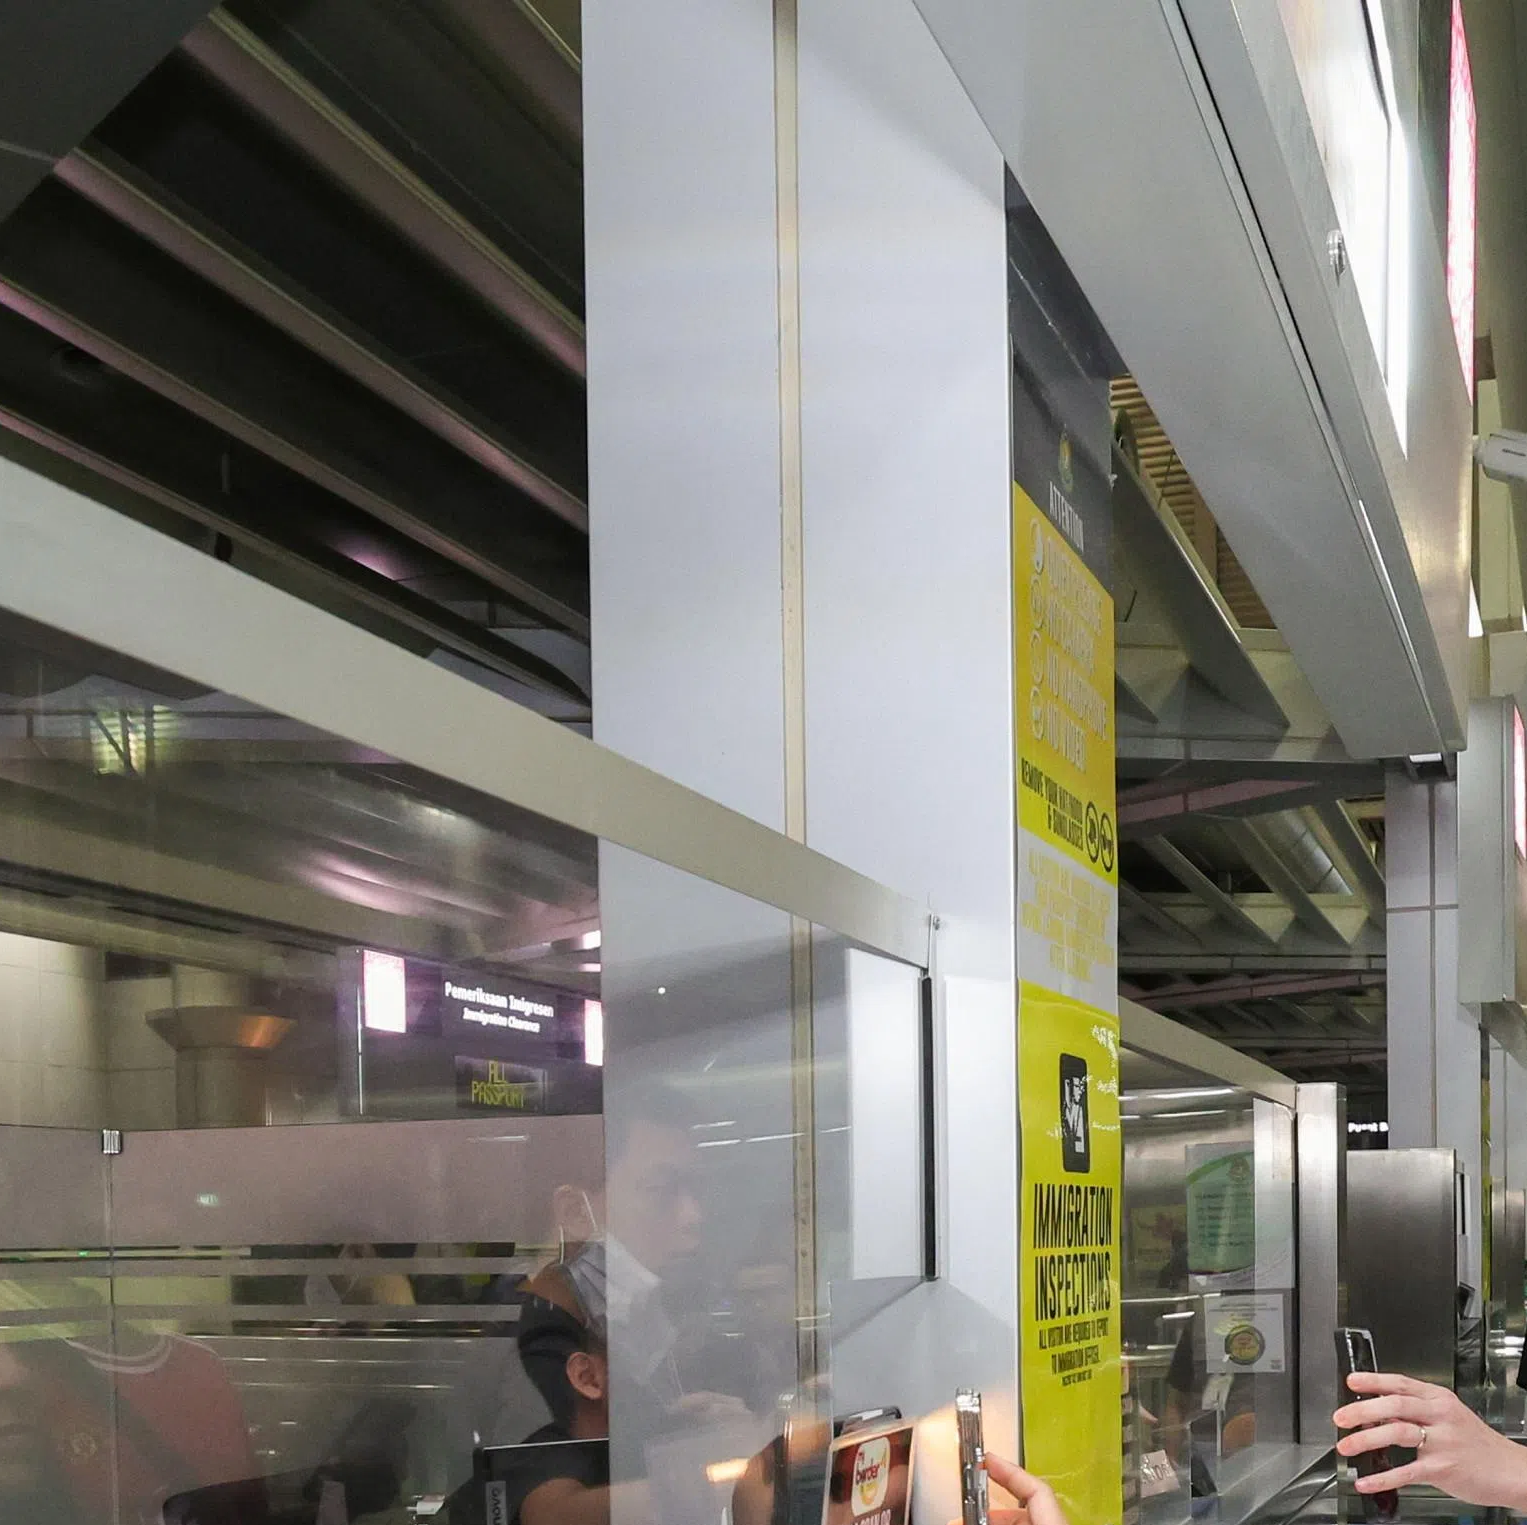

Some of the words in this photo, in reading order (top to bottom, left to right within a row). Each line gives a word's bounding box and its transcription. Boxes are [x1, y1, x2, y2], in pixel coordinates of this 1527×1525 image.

[1049, 482, 1083, 552] ATTENTION
[1033, 1183, 1113, 1249] IMMIGRATION
[1035, 1252, 1111, 1321] INSPECTIONS
